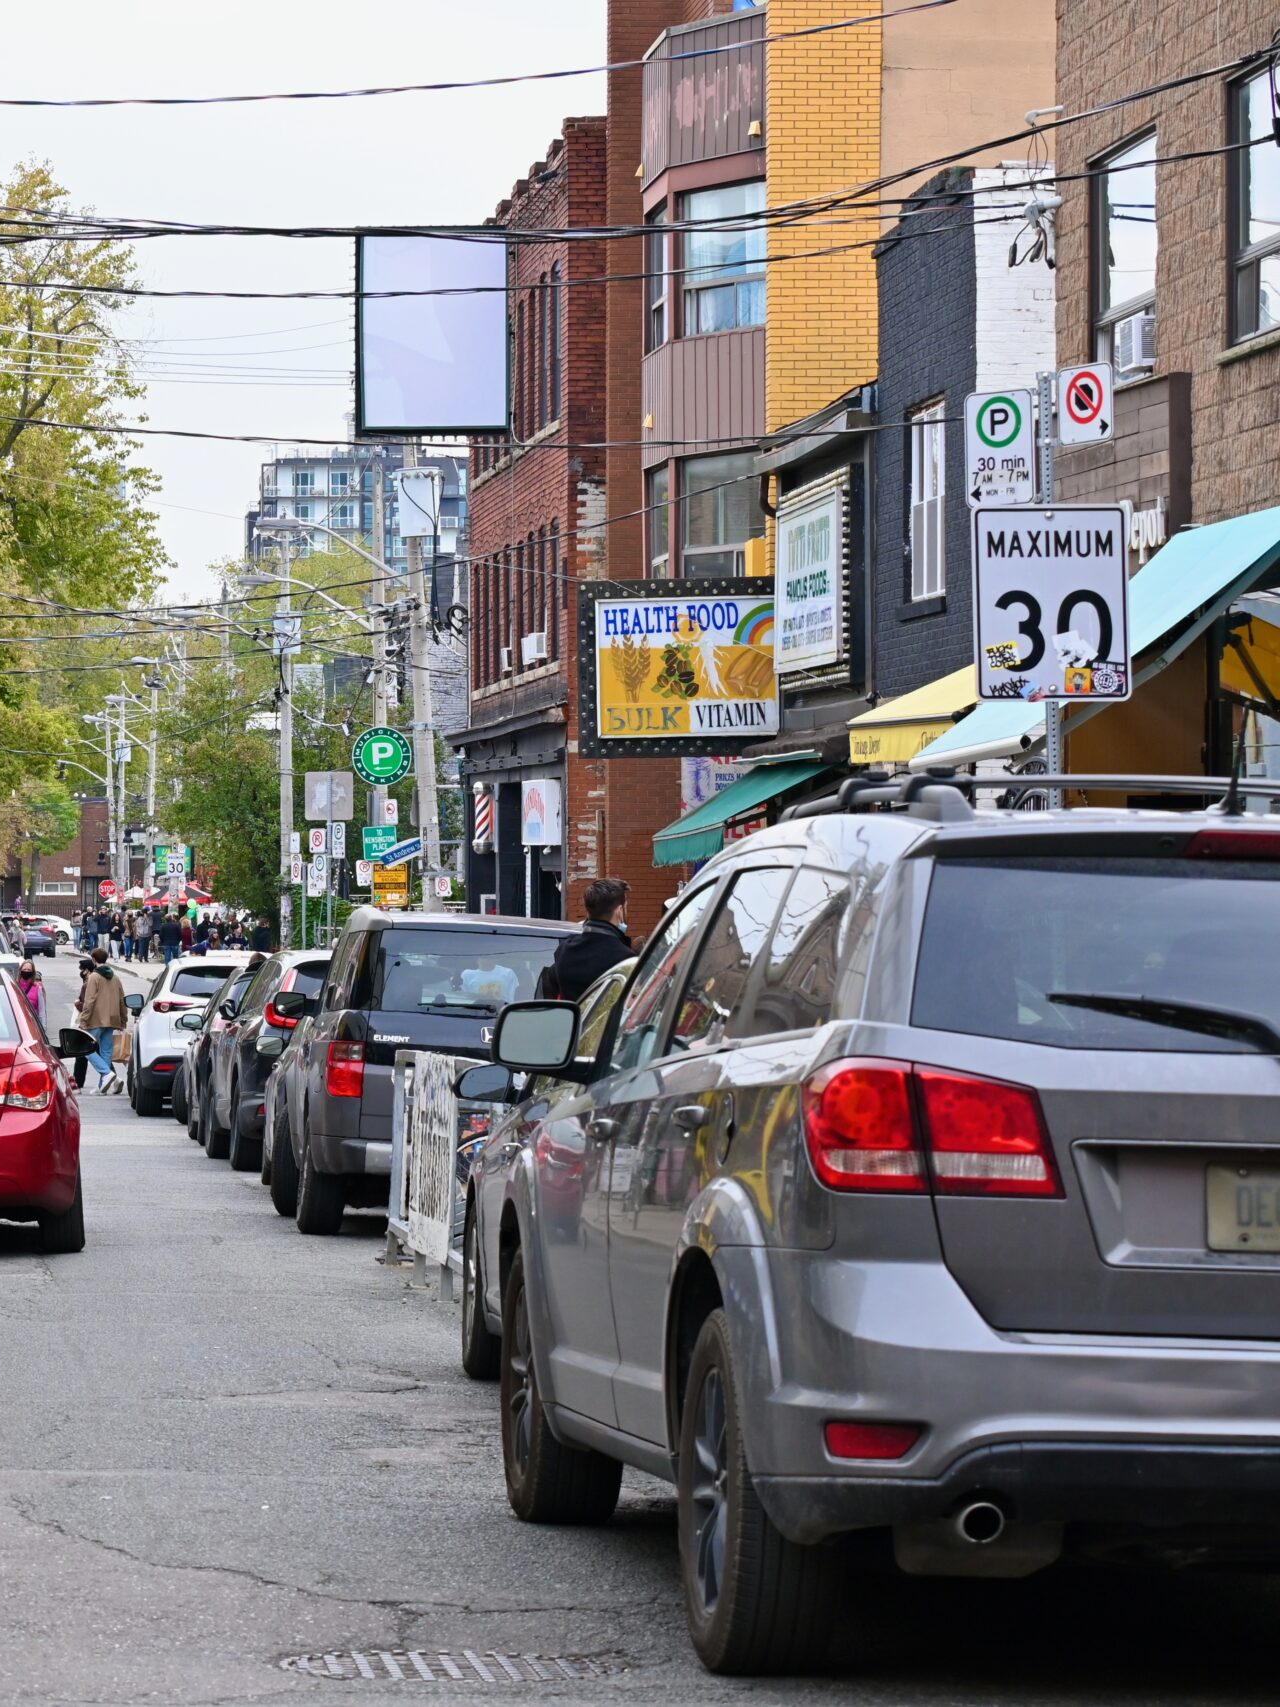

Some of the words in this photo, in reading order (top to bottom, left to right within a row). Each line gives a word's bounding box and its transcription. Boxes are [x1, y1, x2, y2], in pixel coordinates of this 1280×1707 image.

[990, 408, 1009, 436] P
[978, 457, 996, 472] 30
[1001, 455, 1025, 470] min
[972, 472, 979, 486] 7
[982, 474, 992, 484] AM
[1008, 469, 1014, 483] 7
[1016, 470, 1029, 482] PM
[986, 488, 998, 496] MON
[987, 530, 1113, 558] MAXIMUM
[786, 576, 808, 604] FAMOUS
[809, 570, 827, 598] FOODS
[604, 605, 680, 636] HEALTH
[686, 602, 739, 632] FOOD
[994, 589, 1113, 672] 30
[606, 706, 683, 732] BULK
[695, 702, 767, 728] VITAMIN
[355, 729, 407, 756] MUNICIPAL
[372, 742, 394, 765] P
[356, 760, 408, 783] PARKING
[715, 773, 734, 782] PRICES
[385, 854, 393, 862] St
[393, 846, 416, 859] Andrew
[168, 862, 184, 874] 30
[100, 885, 115, 893] STOP
[373, 1034, 410, 1043] ELEMENT
